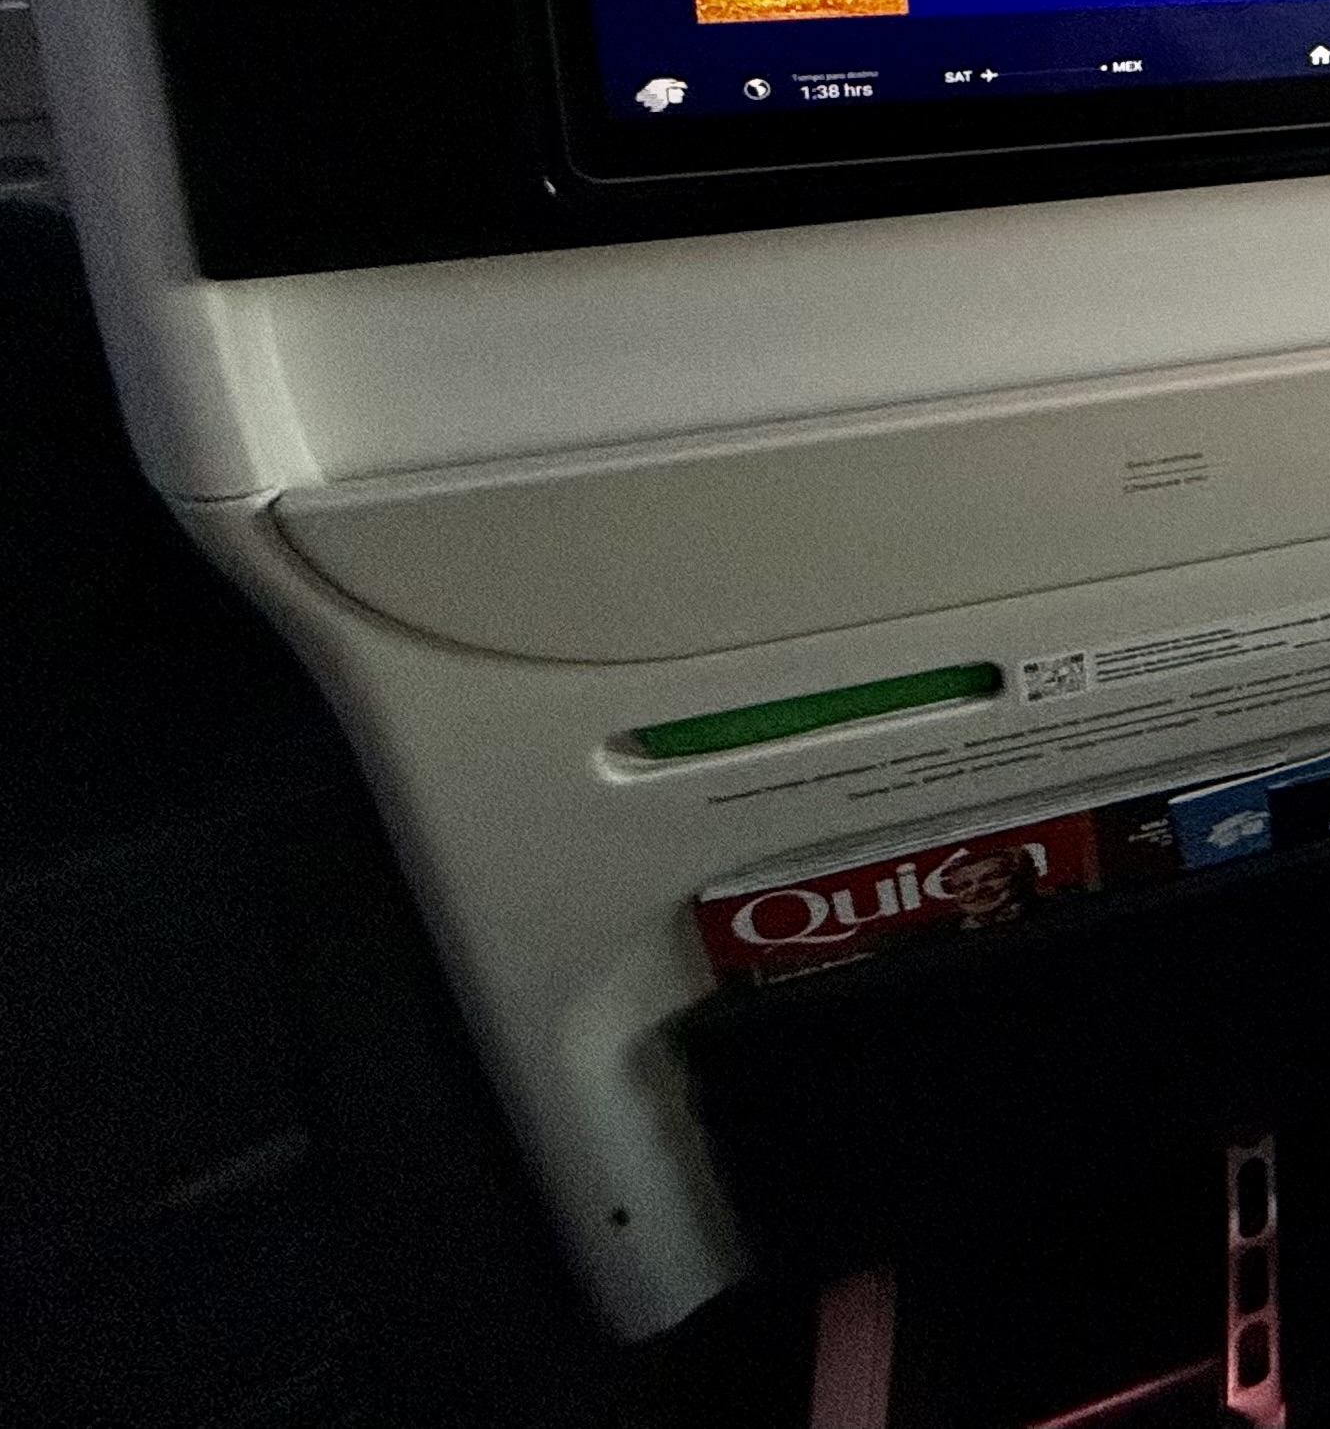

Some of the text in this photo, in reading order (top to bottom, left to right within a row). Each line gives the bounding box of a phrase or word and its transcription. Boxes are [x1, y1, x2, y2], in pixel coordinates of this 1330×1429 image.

[944, 59, 1143, 83] SAT MEX
[800, 82, 874, 101] 1:38 hrs
